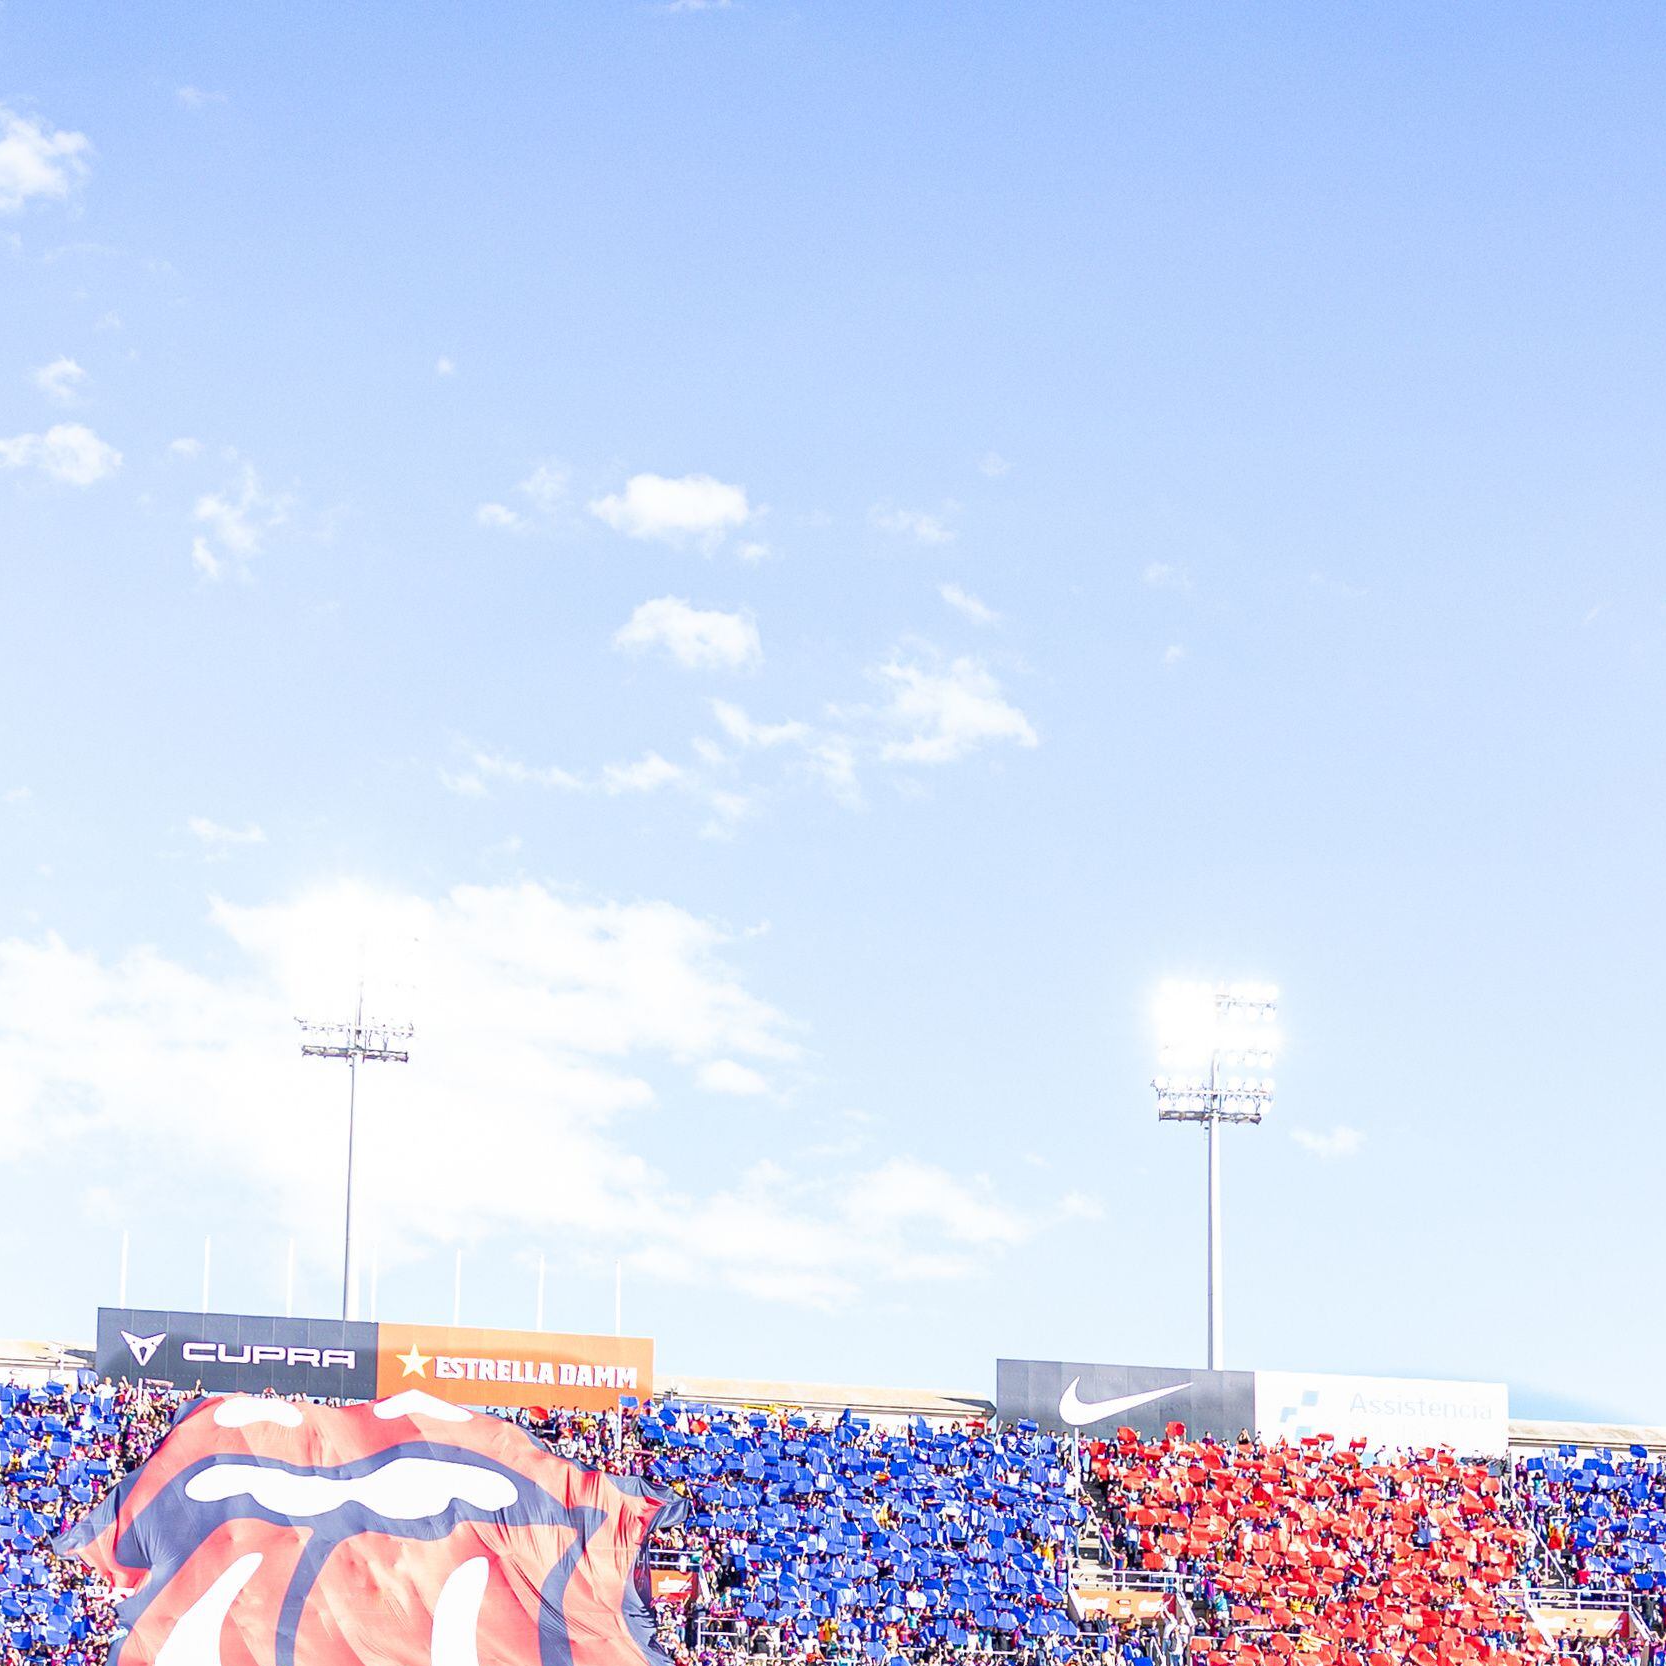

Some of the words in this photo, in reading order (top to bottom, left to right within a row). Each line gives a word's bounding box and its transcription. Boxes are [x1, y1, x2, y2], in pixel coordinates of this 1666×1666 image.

[181, 1341, 356, 1370] CUPRA
[435, 1356, 554, 1386] ESTRELLA
[559, 1363, 638, 1389] DAMM
